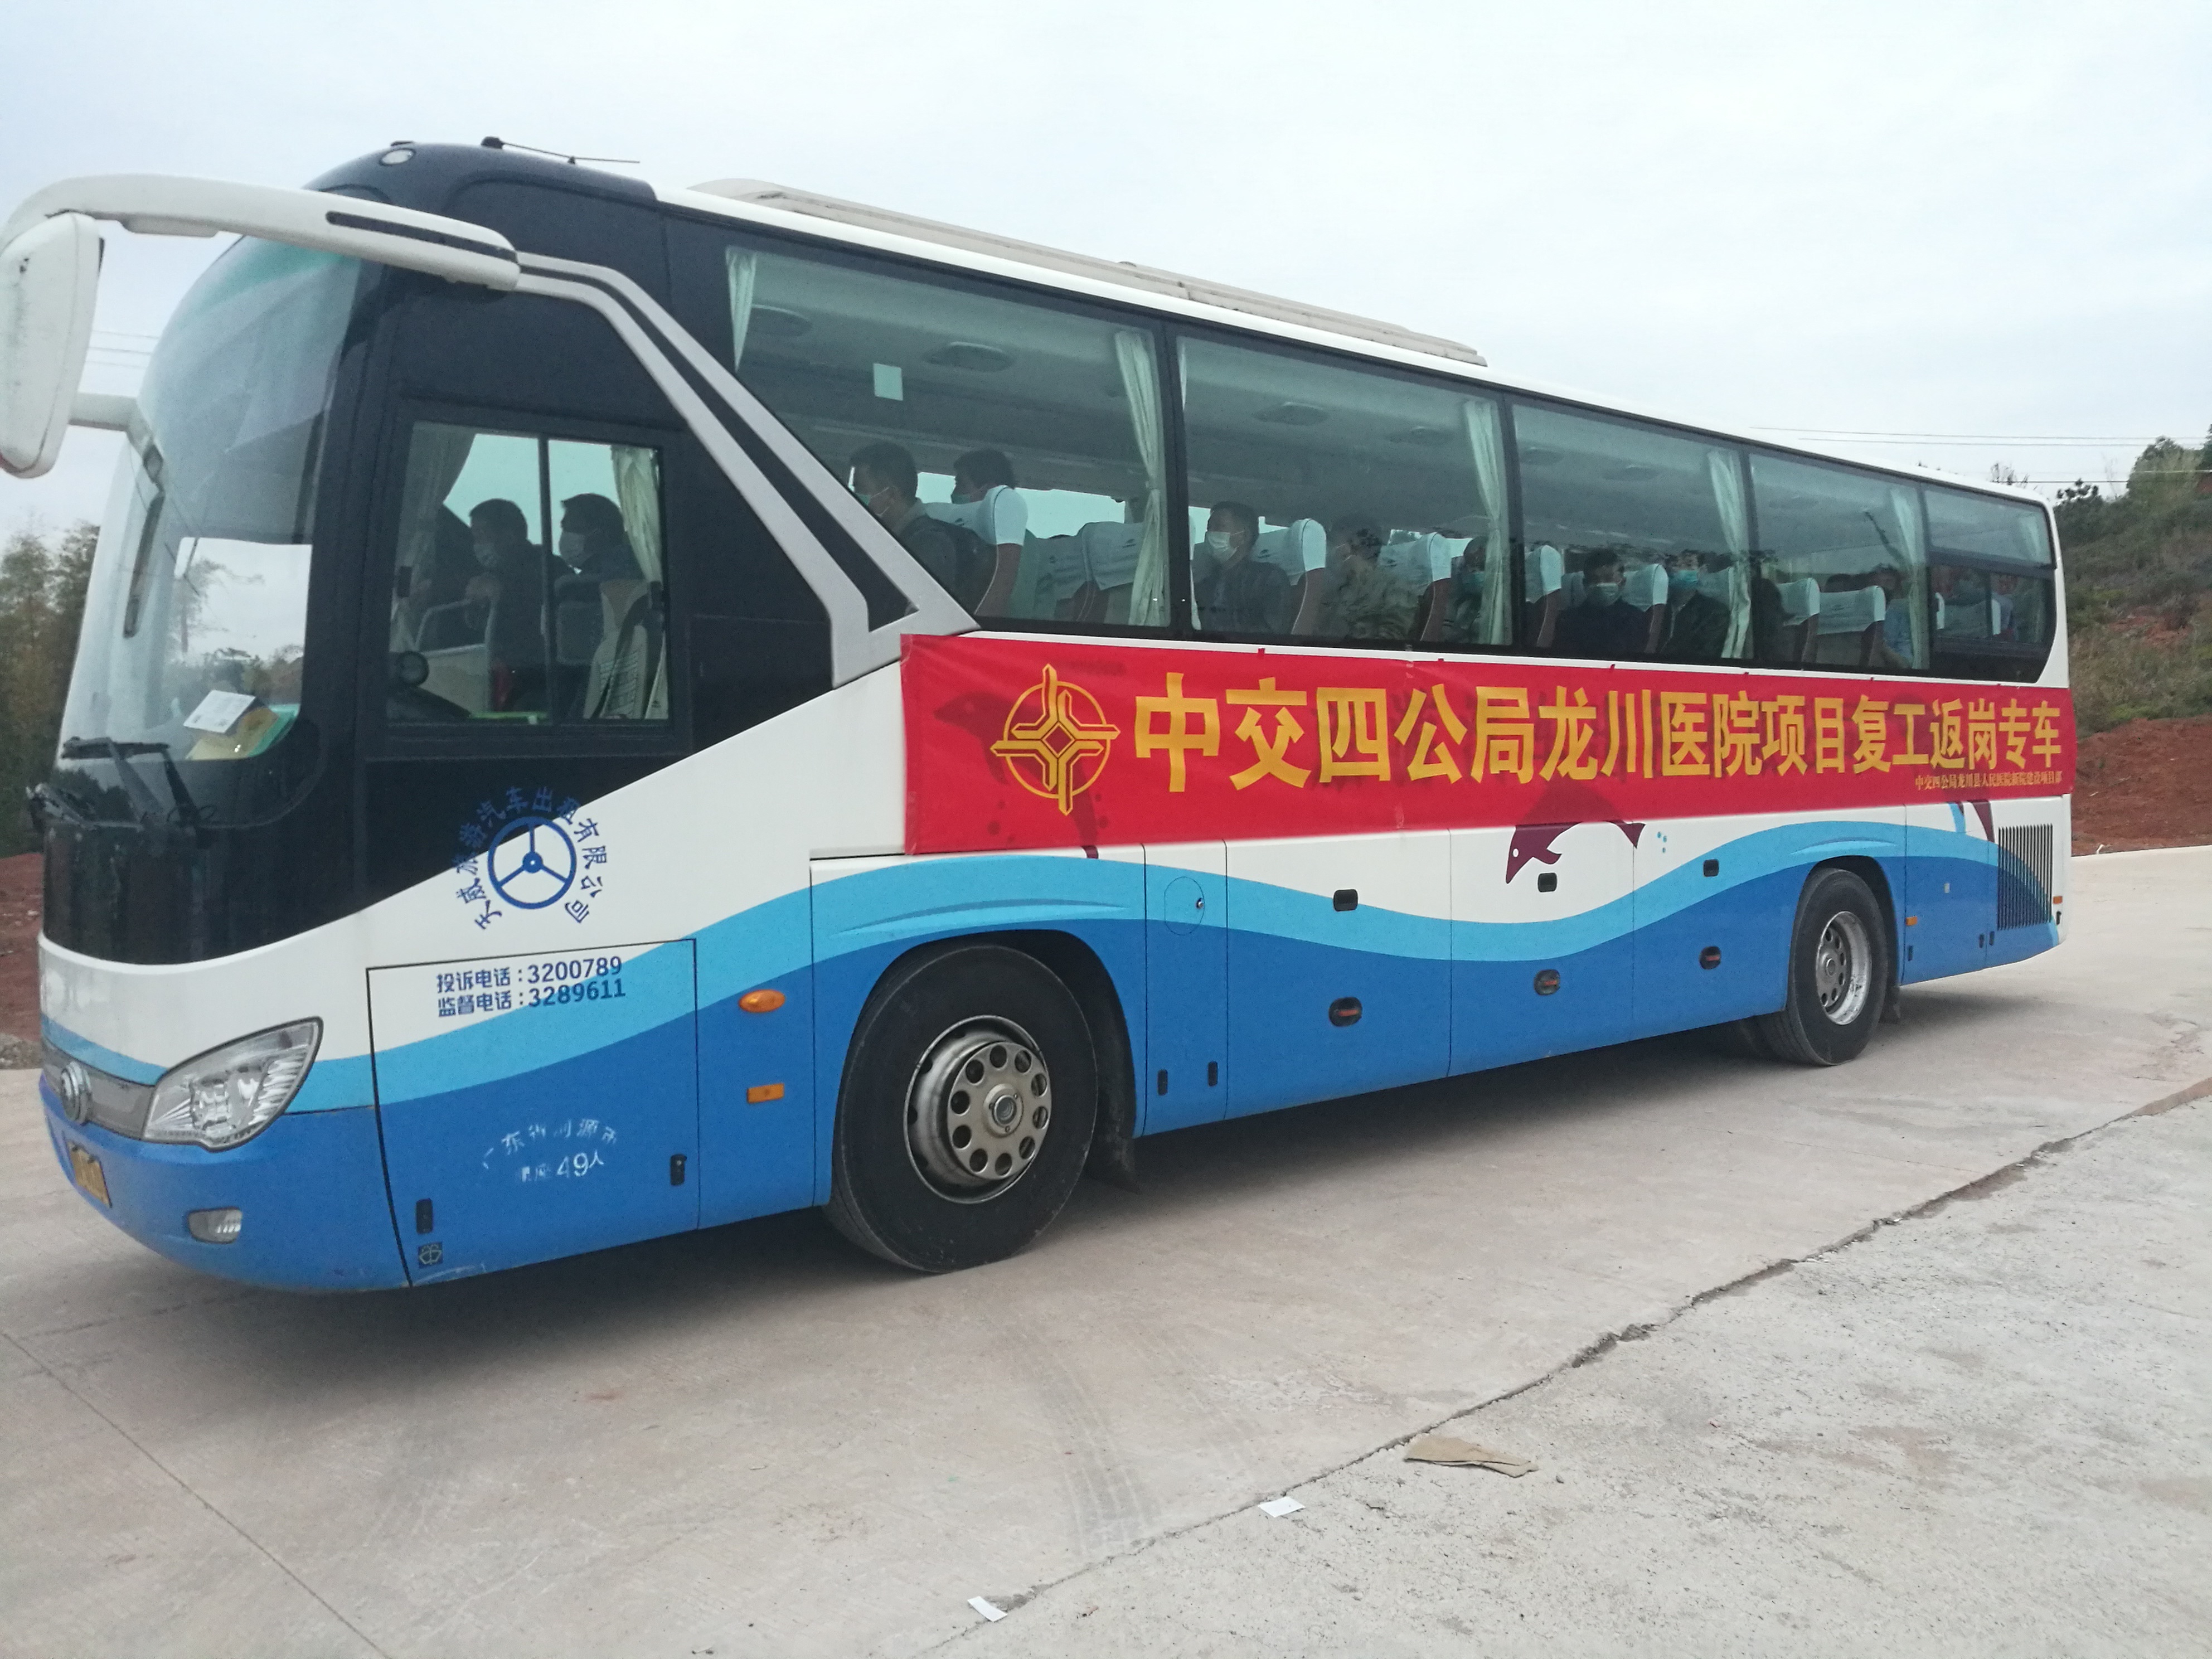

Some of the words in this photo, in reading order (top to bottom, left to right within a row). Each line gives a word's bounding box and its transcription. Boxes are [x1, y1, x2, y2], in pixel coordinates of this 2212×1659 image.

[1135, 673, 2061, 792] 中交四公局龙川医院项目复工返岗专车
[452, 786, 608, 930] 天威旅游汽车出租有限公司
